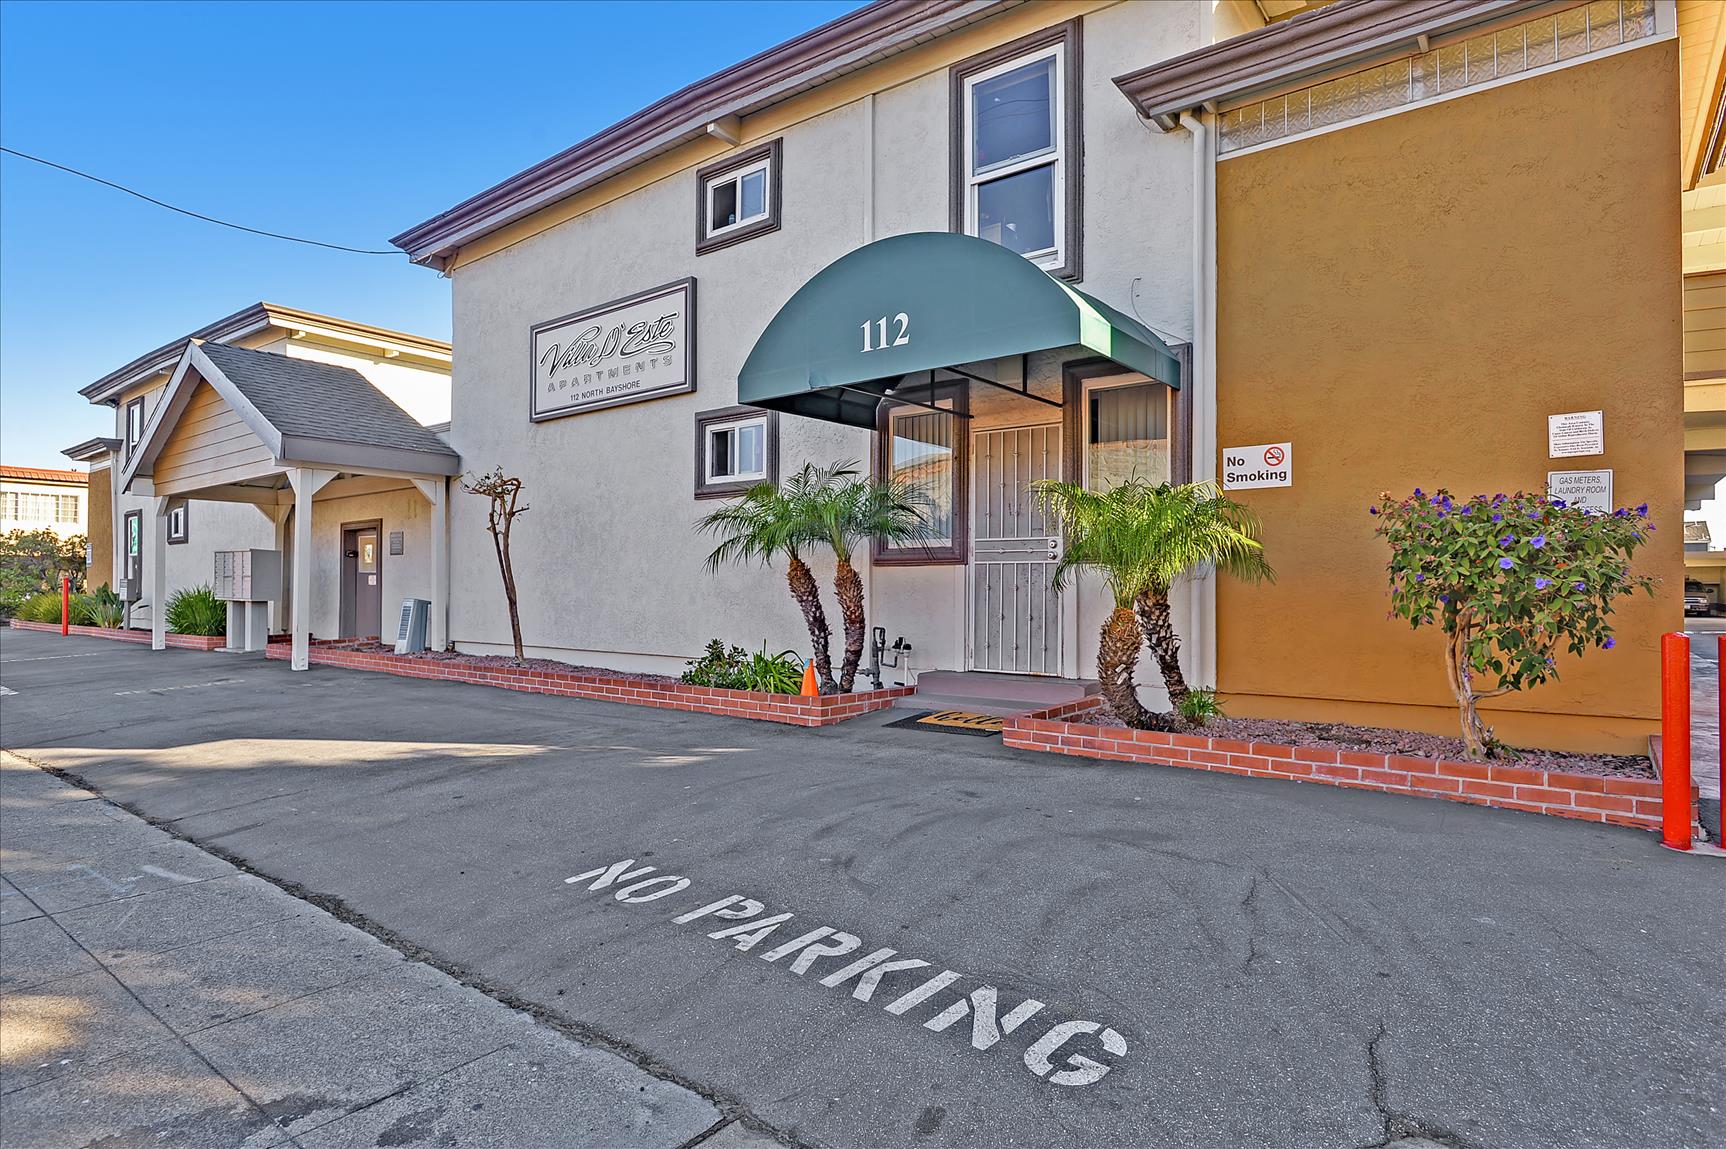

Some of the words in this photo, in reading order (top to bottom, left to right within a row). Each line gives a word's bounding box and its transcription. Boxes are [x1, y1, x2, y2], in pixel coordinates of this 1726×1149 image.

[859, 312, 910, 354] 112
[540, 325, 602, 378] Villa
[547, 354, 673, 393] APARTMENTS
[570, 394, 580, 402] 112
[581, 388, 604, 400] NORTH
[606, 380, 641, 395] BAYSHORE
[1227, 456, 1245, 467] No
[1227, 470, 1287, 482] Smoking
[1559, 477, 1573, 485] GAS
[1554, 486, 1585, 495] LAUNDRY
[1585, 485, 1607, 494] ROOM
[564, 858, 692, 904] NO
[671, 894, 1128, 1086] PARKING
